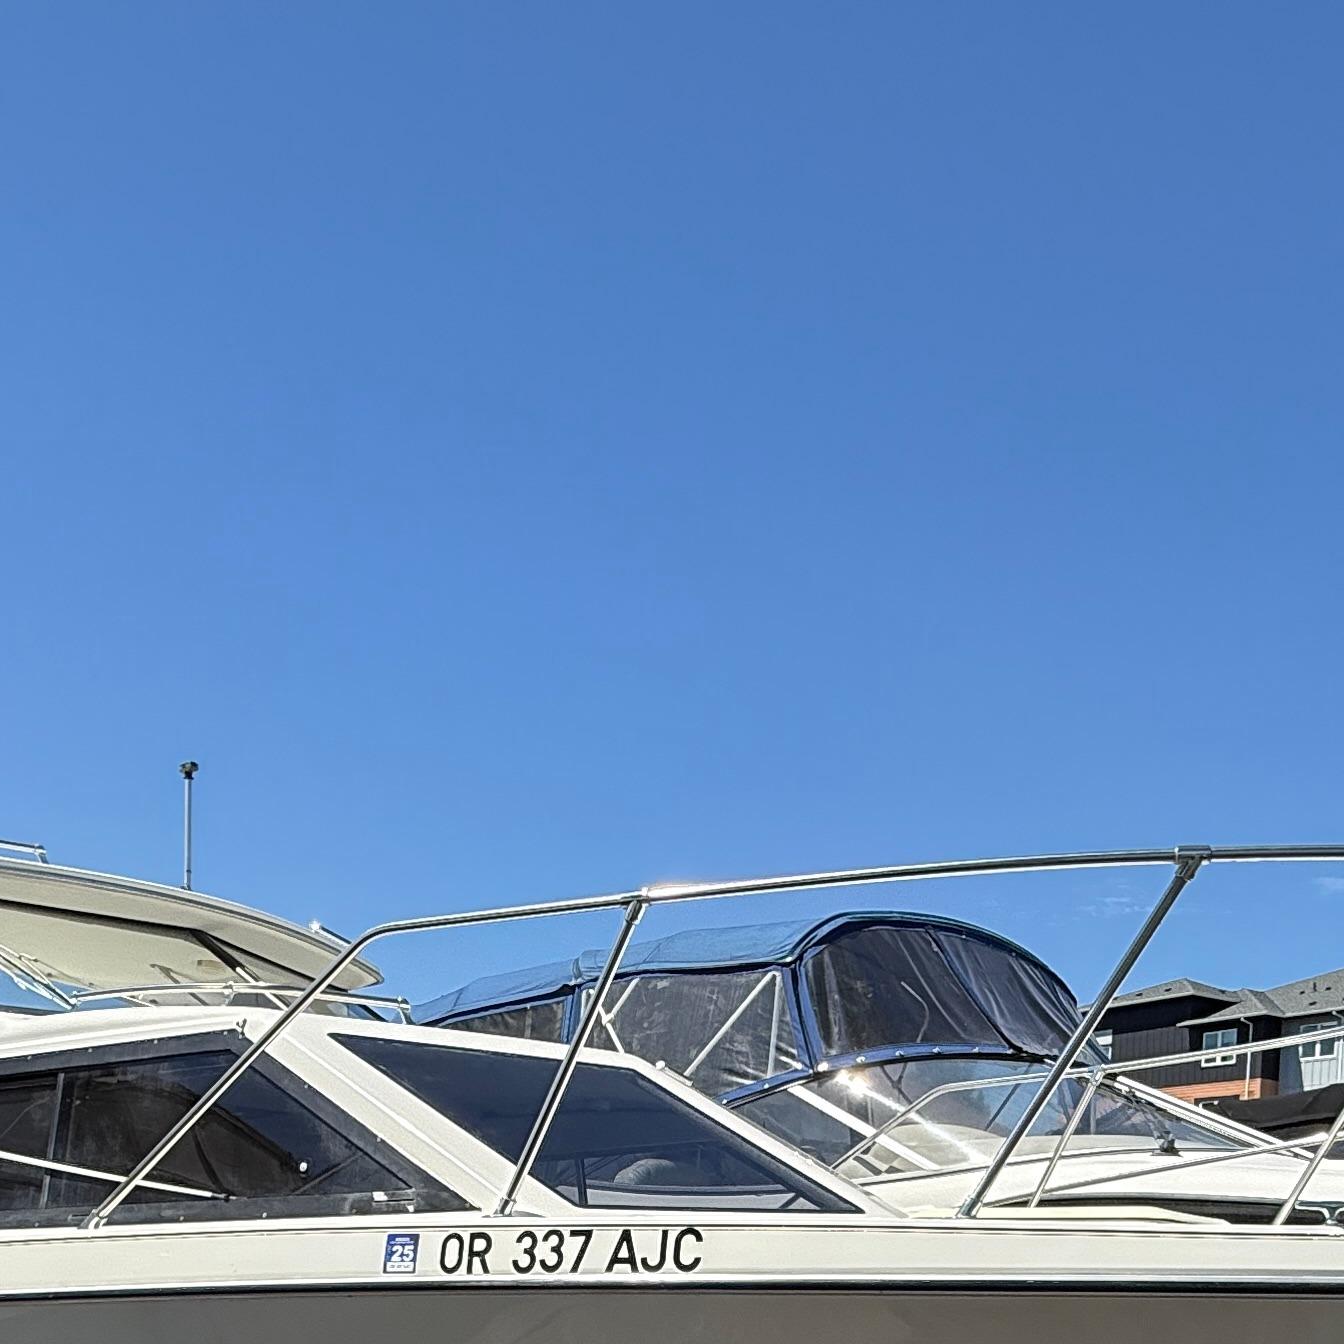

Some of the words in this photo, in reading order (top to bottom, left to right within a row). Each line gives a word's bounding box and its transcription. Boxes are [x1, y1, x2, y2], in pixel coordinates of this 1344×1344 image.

[391, 1245, 415, 1261] 25
[440, 1232, 493, 1275] OR
[512, 1229, 594, 1274] 337
[604, 1227, 704, 1274] AJC
